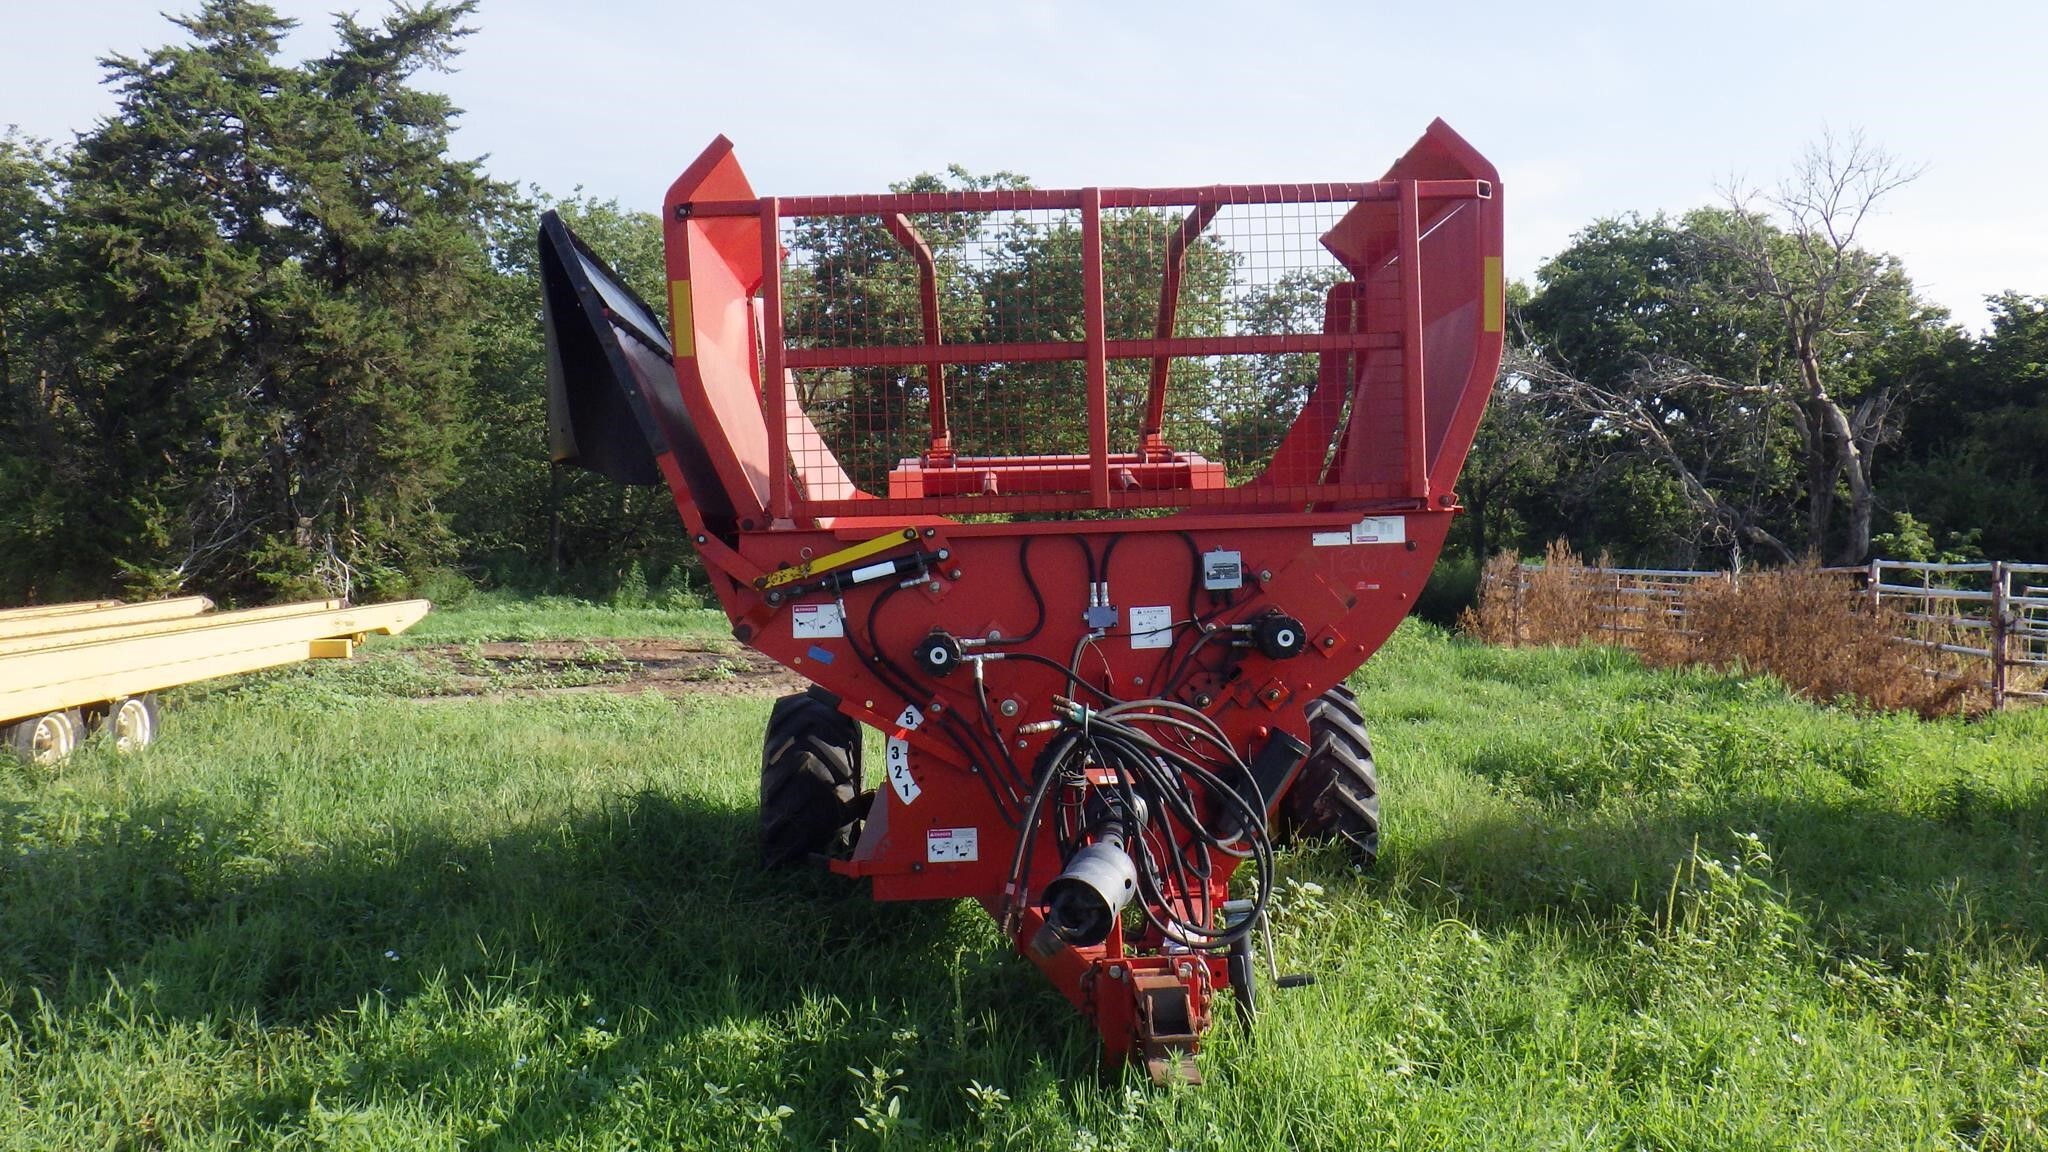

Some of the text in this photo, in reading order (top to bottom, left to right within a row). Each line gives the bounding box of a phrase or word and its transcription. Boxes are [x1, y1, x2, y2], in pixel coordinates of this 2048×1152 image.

[905, 711, 914, 725] 5
[891, 746, 900, 760] 3
[894, 765, 902, 779] 2
[902, 783, 909, 797] 1
